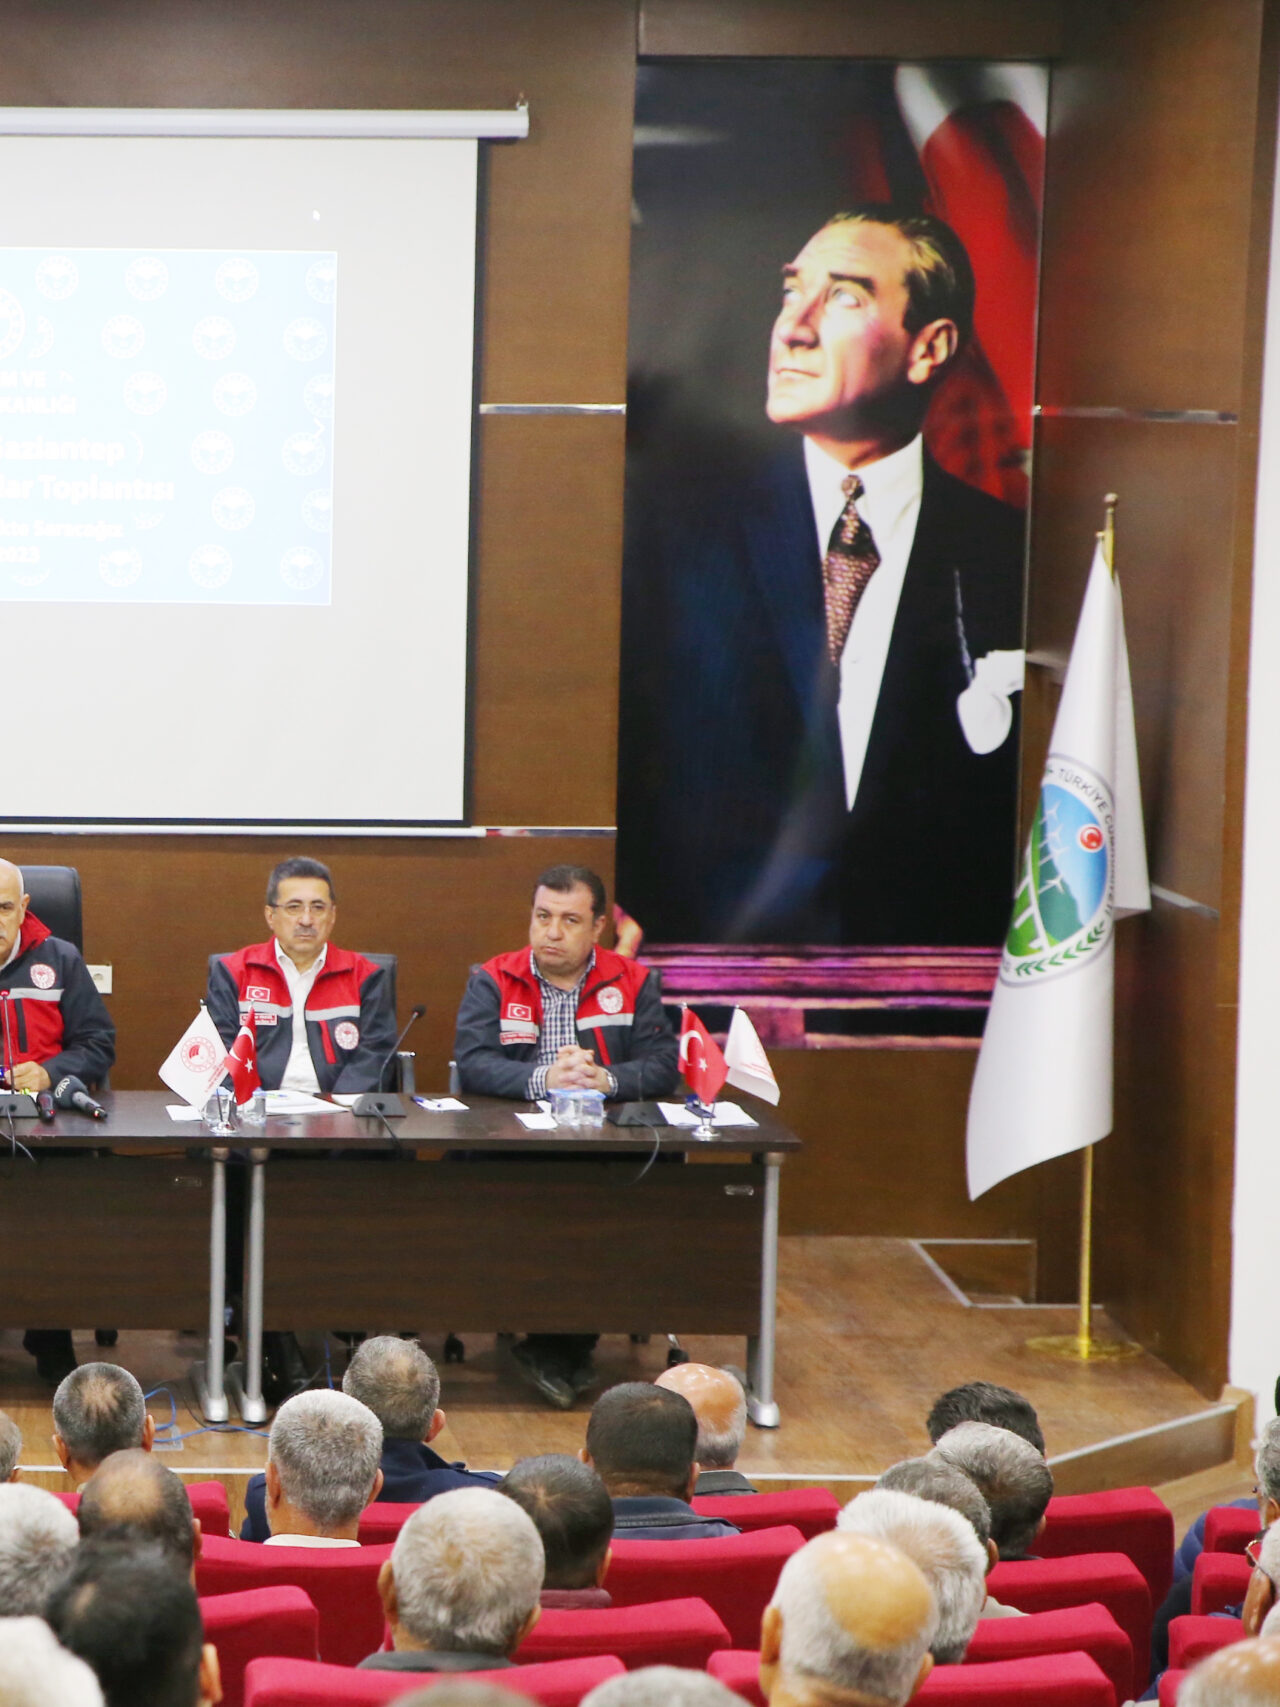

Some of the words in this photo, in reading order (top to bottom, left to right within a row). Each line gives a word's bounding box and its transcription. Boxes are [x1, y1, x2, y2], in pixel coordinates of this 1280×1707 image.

[21, 370, 48, 389] VE
[37, 473, 174, 504] Toplantısı
[1059, 767, 1109, 813] TÜRKİYE
